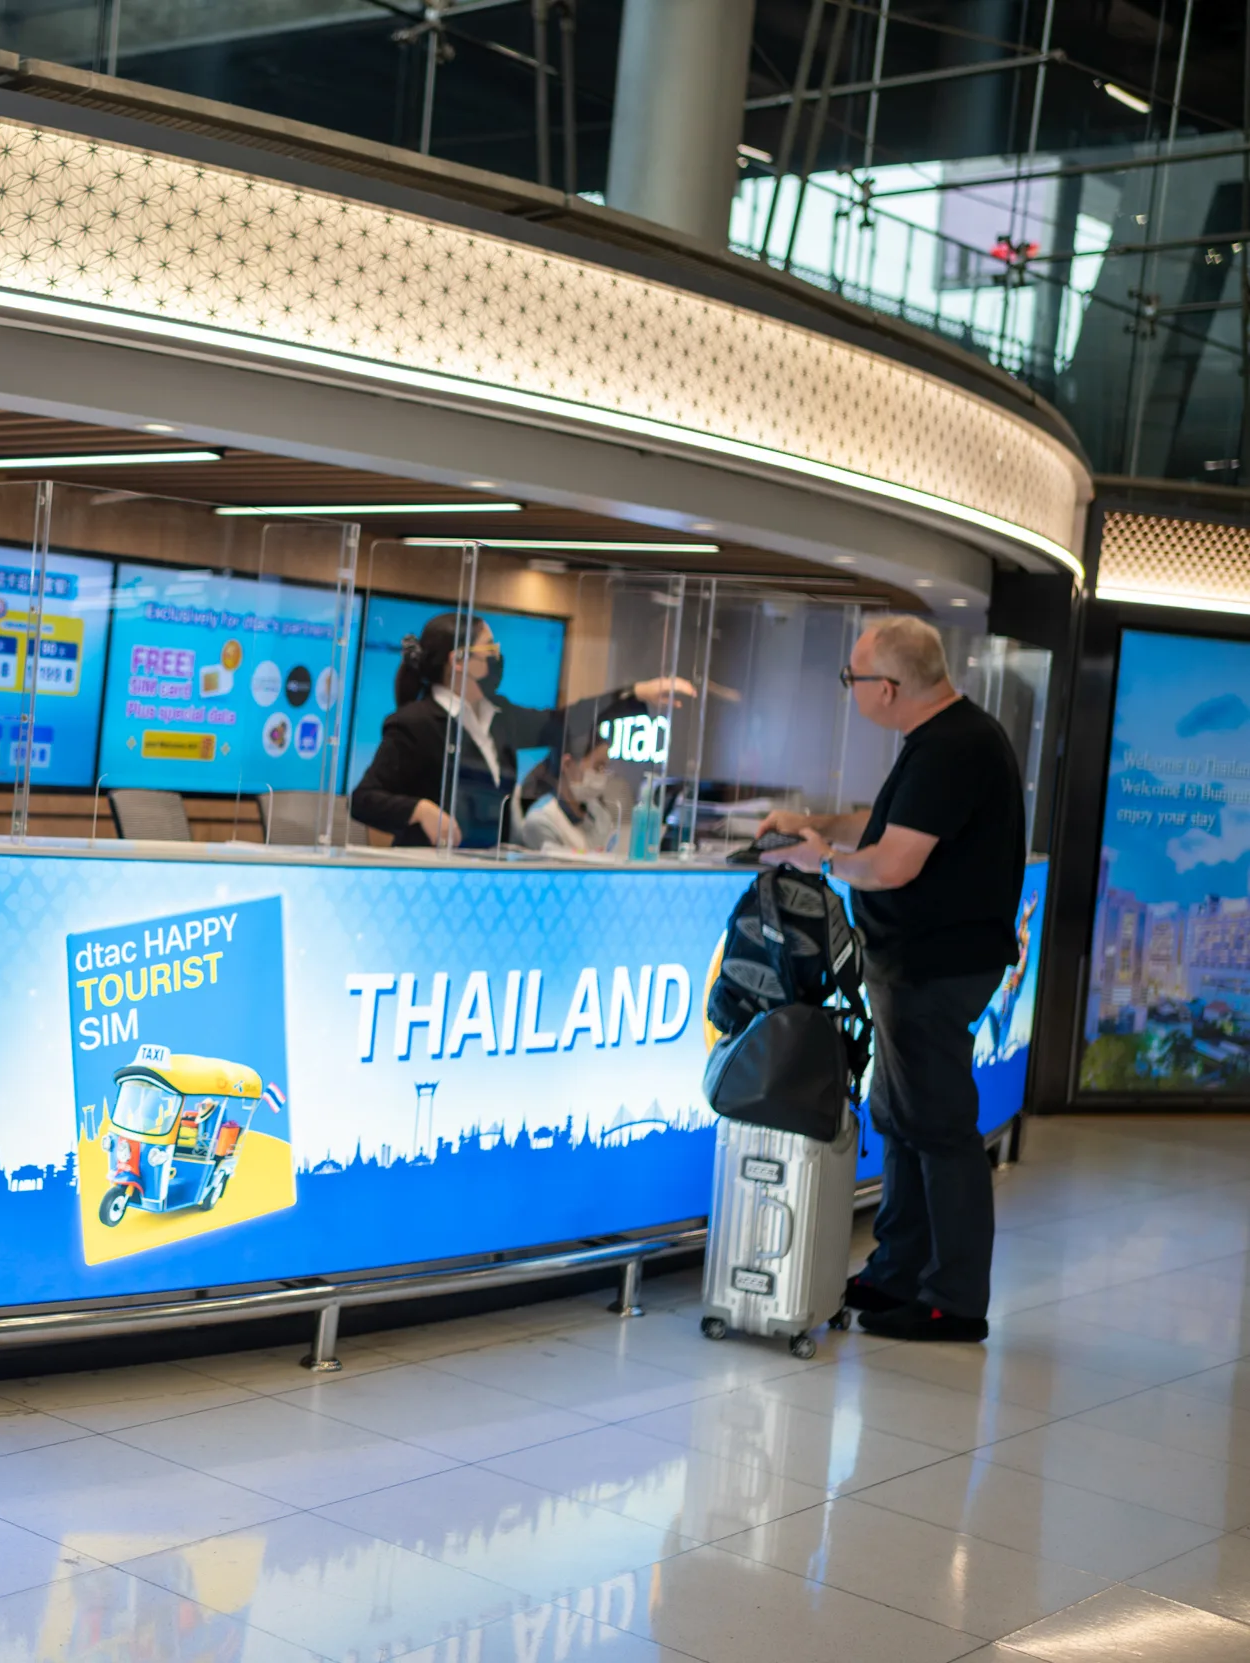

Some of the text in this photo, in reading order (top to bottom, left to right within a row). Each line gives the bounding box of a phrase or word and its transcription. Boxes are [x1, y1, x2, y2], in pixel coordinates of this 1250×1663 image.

[74, 912, 239, 975] dtac HAPPY
[76, 951, 225, 1012] TOURIST
[77, 1007, 141, 1052] SIM
[345, 962, 693, 1064] THAILAND
[141, 1046, 165, 1063] TAXI
